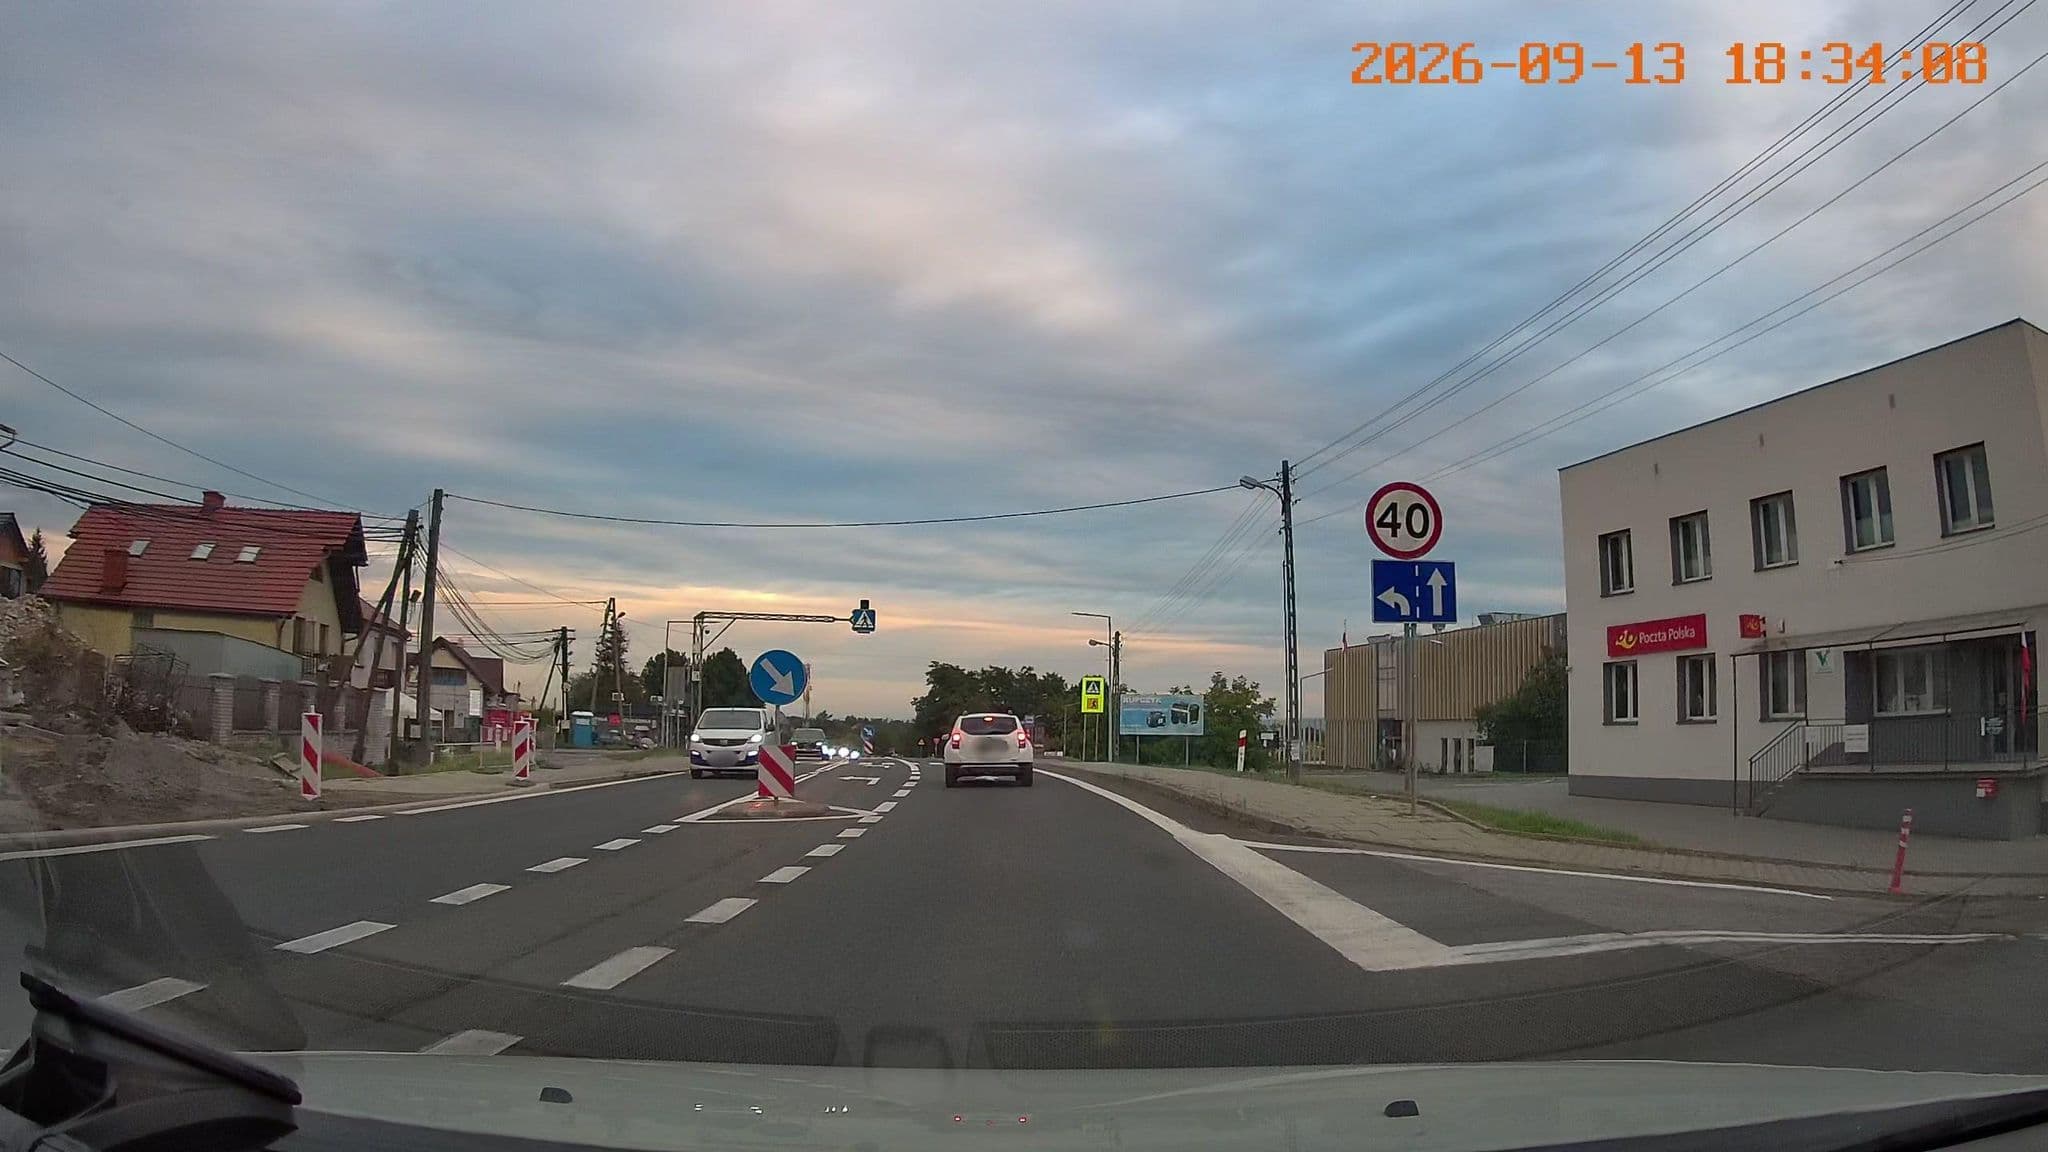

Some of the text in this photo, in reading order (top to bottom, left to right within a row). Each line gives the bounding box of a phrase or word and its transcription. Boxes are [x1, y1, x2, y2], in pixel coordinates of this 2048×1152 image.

[1376, 502, 1430, 539] 40
[1638, 625, 1696, 645] Poczta Polska
